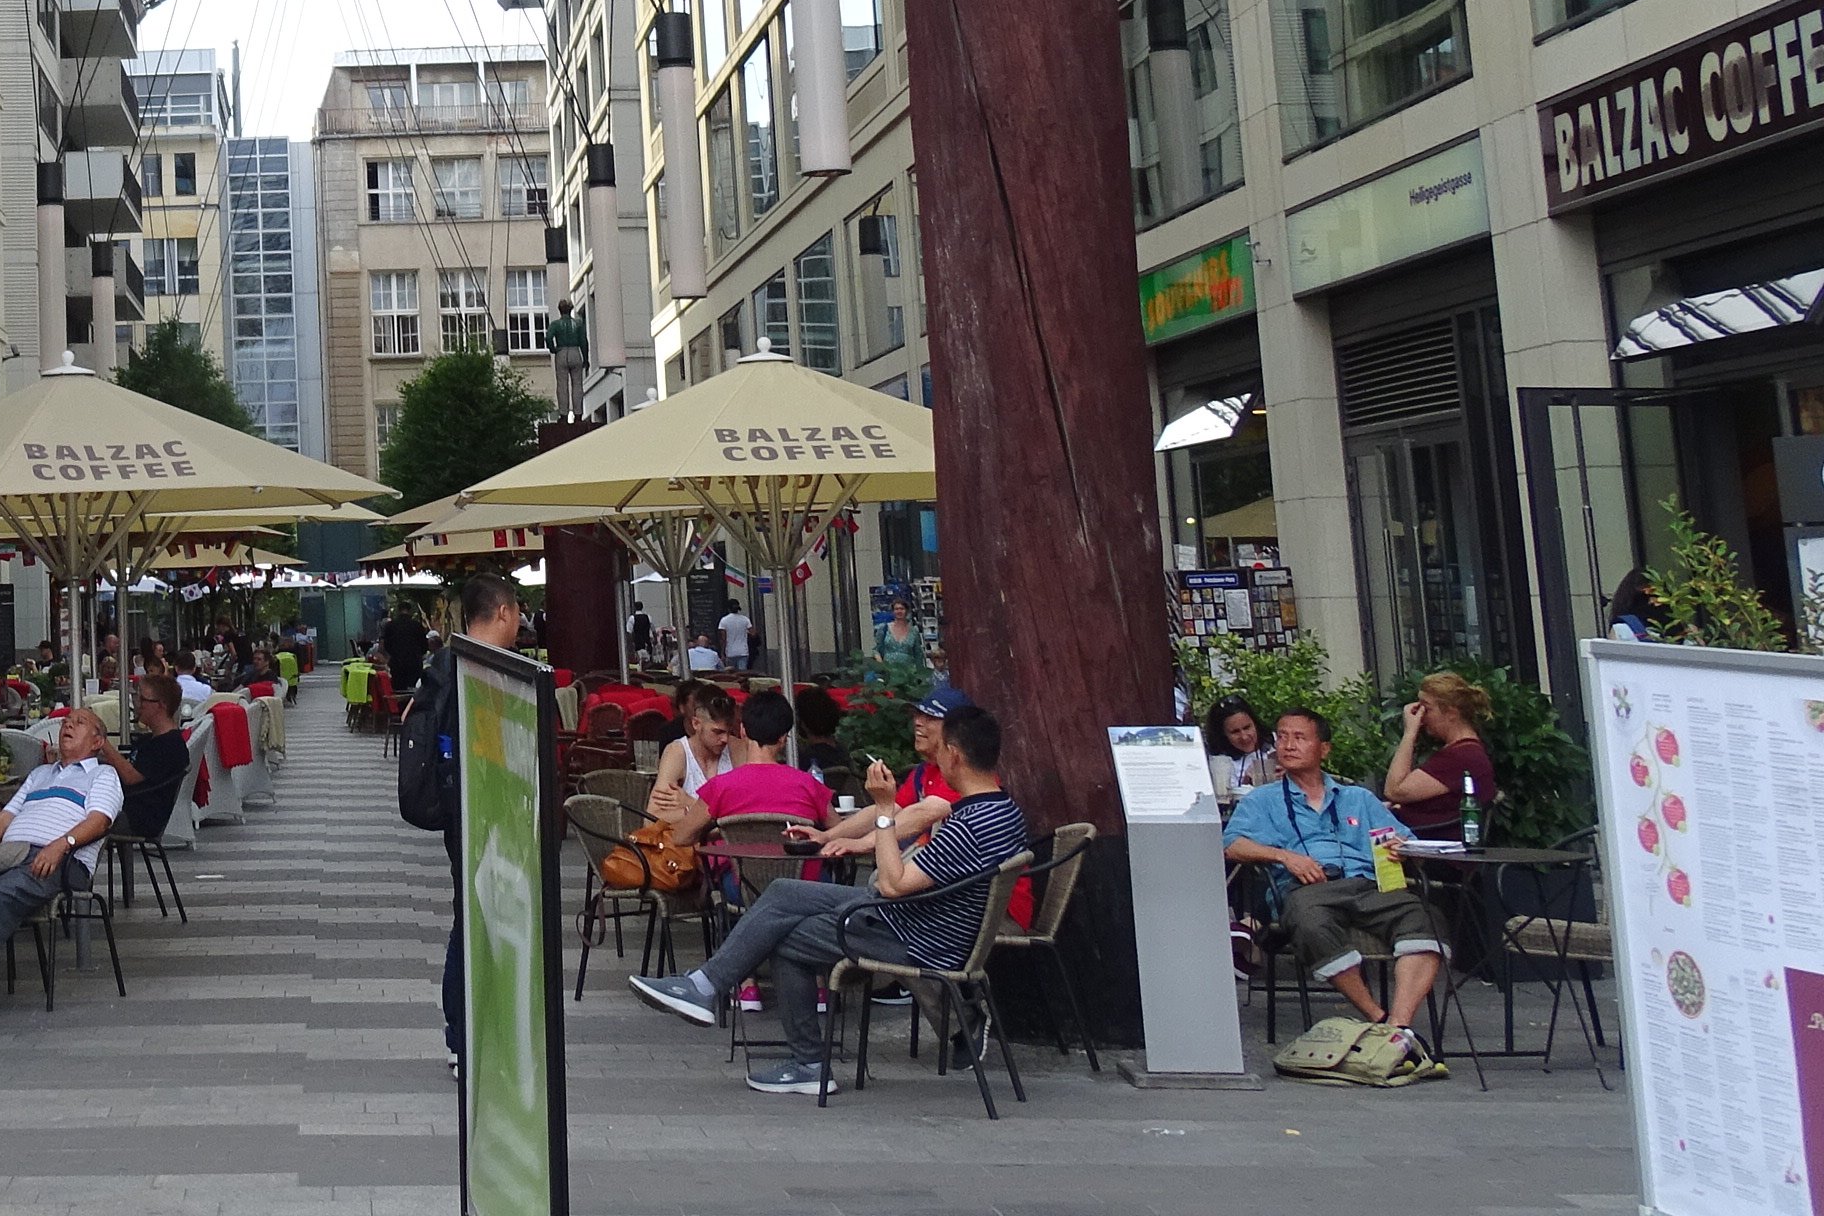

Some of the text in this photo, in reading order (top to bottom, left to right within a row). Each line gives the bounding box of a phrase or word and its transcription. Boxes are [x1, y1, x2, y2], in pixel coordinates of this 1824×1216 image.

[1554, 67, 1690, 193] BALZAC
[1409, 171, 1473, 207] Heiligegeistgasse
[714, 424, 887, 443] BALZAC
[23, 440, 187, 461] BALZAC
[722, 443, 897, 462] COFFEE
[32, 460, 196, 481] COFFEE
